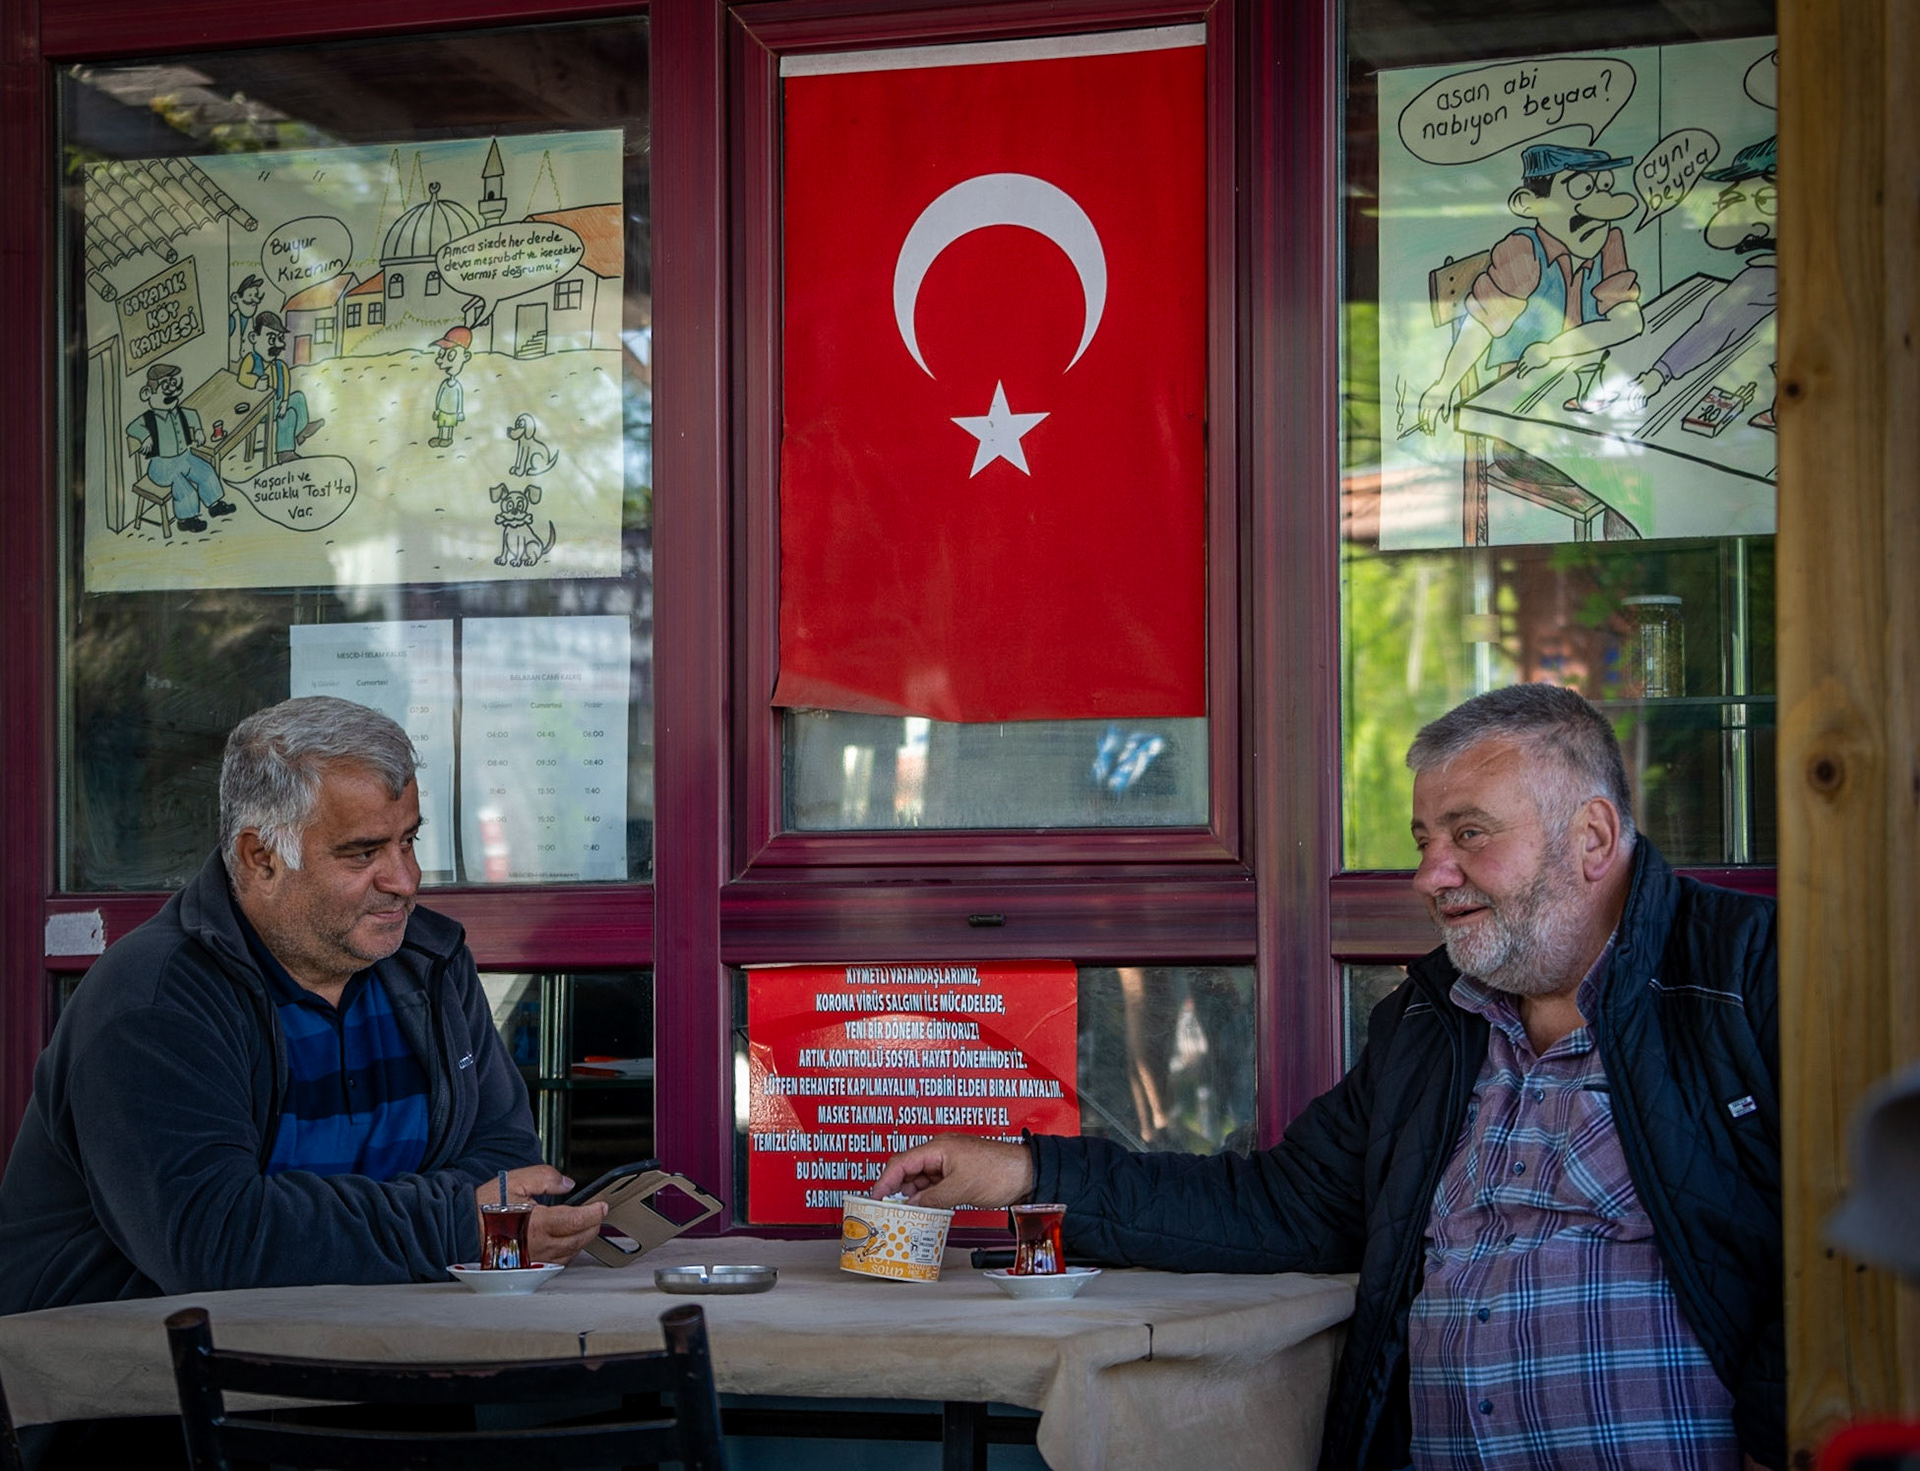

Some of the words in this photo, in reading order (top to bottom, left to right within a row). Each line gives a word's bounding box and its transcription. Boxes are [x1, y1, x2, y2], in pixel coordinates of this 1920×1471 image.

[1437, 83, 1490, 111] asan
[1503, 67, 1539, 95] abi
[1648, 147, 1710, 212] beyaa
[270, 237, 317, 265] Buyur
[442, 243, 476, 260] Amca
[443, 259, 472, 272] deva
[123, 270, 187, 317] BOYALIK
[146, 300, 180, 331] KÖY
[129, 305, 199, 360] KAHVESİ
[297, 472, 312, 482] ve
[254, 486, 300, 503] sucuklu
[356, 679, 389, 688] Cumartesi
[530, 701, 563, 709] Cumartesi
[890, 967, 982, 989] VATANDAŞLARIMIZ,
[816, 993, 855, 1012] KORONA
[856, 989, 884, 1012] VİRÜS
[885, 993, 923, 1012] SALGINI
[924, 990, 939, 1012] İLE
[940, 990, 1006, 1015] MÜCADELEDE,
[845, 1018, 867, 1040] YENİ
[868, 1018, 884, 1040] BİR
[885, 1018, 925, 1040] DÖNEME
[926, 1018, 980, 1041] GİRİYORUZ!
[885, 1049, 920, 1069] SOSYAL
[922, 1050, 951, 1069] HAYAT
[952, 1045, 1028, 1070] DÖNEMİNDEYİZ.
[763, 1073, 798, 1096] LÜTFEN
[799, 1077, 846, 1096] REHAVETE
[957, 1078, 987, 1097] ELDEN
[989, 1079, 1018, 1098] BIRAK
[1019, 1079, 1064, 1098] MAYALIM.
[818, 1105, 850, 1124] MASKE
[851, 1106, 894, 1124] TAKMAYA
[935, 1107, 983, 1126] MESAFEYE
[984, 1107, 998, 1126] VE
[998, 1107, 1010, 1126] EL
[753, 1129, 812, 1152] TEMİZLİĞİNE
[813, 1130, 847, 1152] DİKKAT
[848, 1130, 886, 1152] EDELİM.
[887, 1131, 907, 1153] TÜM
[796, 1161, 810, 1180] BU
[870, 1264, 904, 1277] soup
